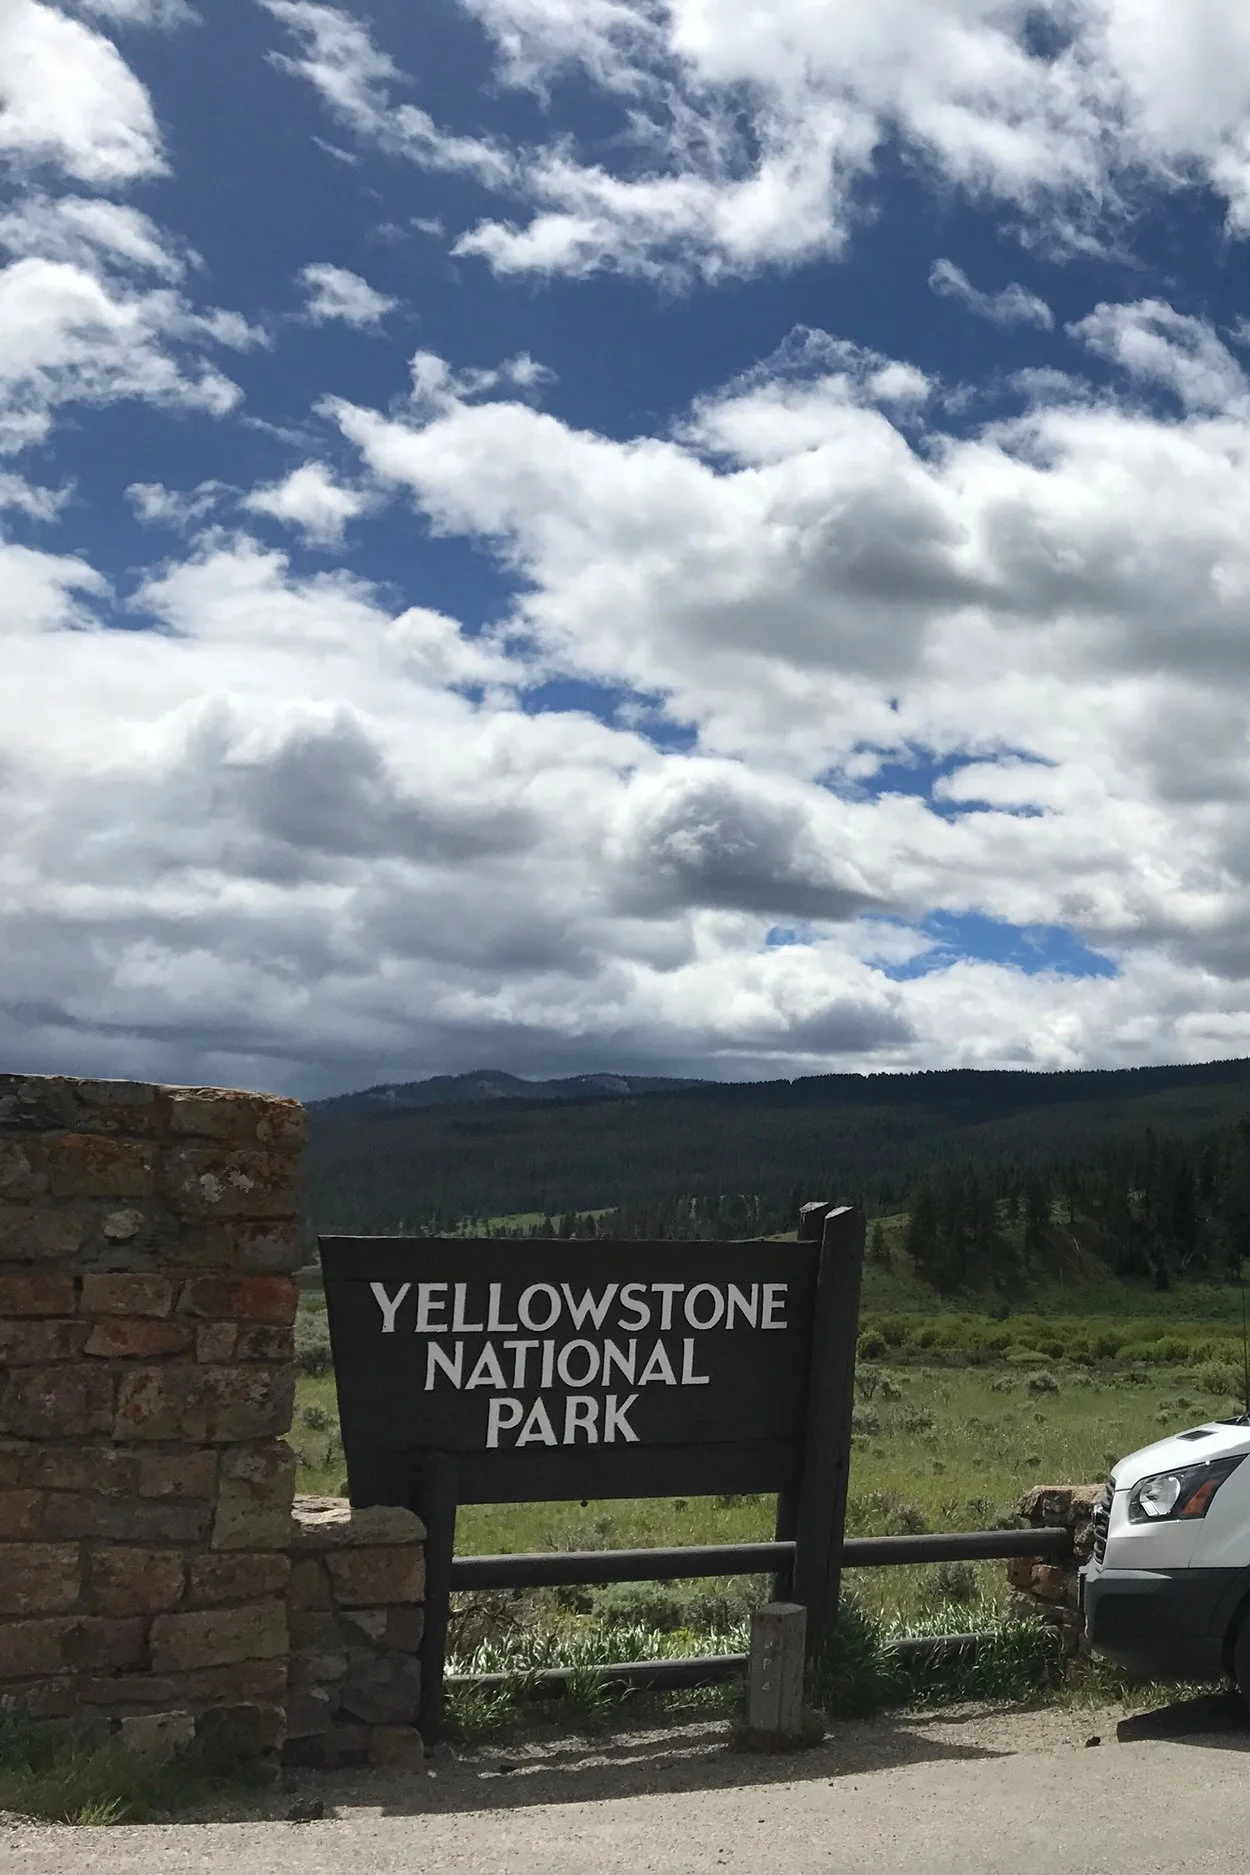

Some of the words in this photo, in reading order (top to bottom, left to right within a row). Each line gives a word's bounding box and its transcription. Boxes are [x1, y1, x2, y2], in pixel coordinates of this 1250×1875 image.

[370, 1282, 789, 1333] YELLOWSTONE
[424, 1337, 710, 1391] NATIONAL
[485, 1393, 640, 1448] PARK
